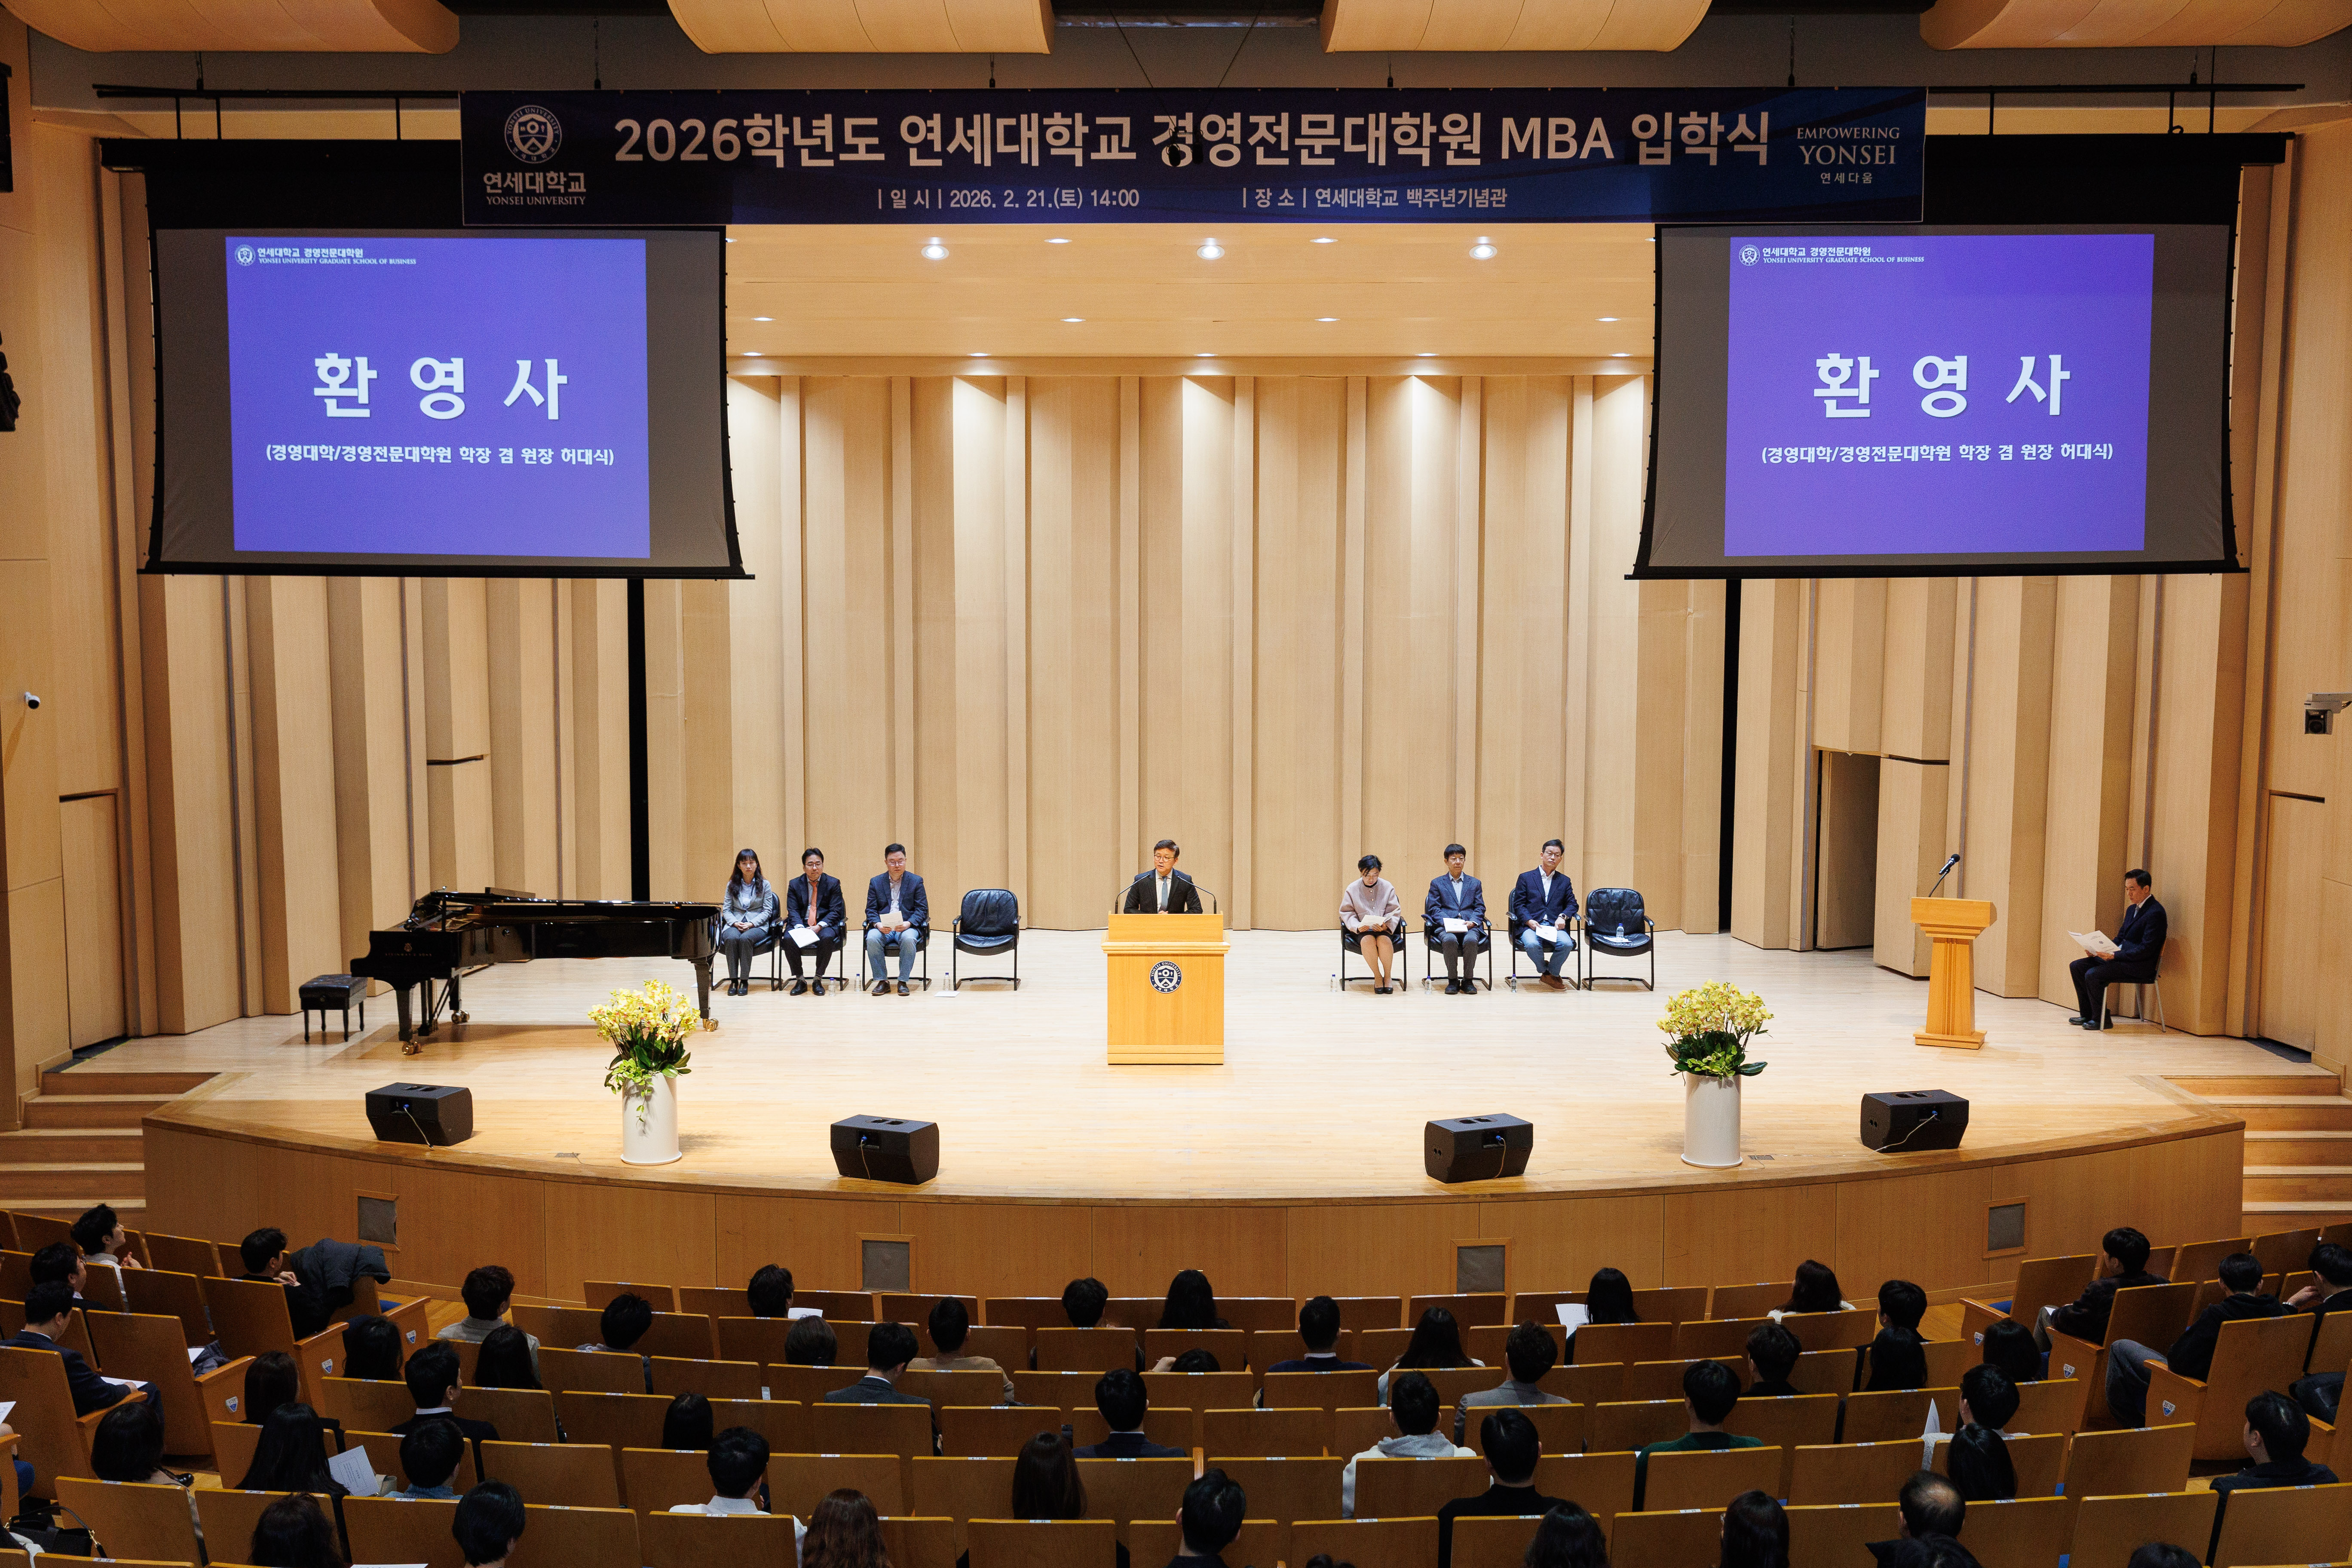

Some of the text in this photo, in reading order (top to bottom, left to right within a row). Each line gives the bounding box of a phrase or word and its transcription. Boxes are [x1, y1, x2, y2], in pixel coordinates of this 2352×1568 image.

[615, 112, 1768, 168] 2026학년도 연세대학교 경영전문대학원 MBA 입학식
[1797, 127, 1899, 139] EMPOWERING
[1800, 145, 1895, 165] YONSEI
[484, 172, 586, 193] 연세대학교
[487, 196, 585, 205] YONSEI UNIVERSITY
[1091, 189, 1139, 206] 14:00
[1316, 188, 1398, 208] 연세대학교
[1407, 188, 1507, 208] 백주년기념관
[257, 248, 363, 257] 연세대학교 경영전문대학원
[1763, 247, 1805, 256] 연세대학교
[1810, 247, 1870, 256] 경영전문대학원
[267, 445, 613, 465] (경영대학/경영전문대학원 학장 겸 원장 허대식)
[1762, 444, 2113, 463] (경영대학/경영전문대학원 학장 겸 원장 허대식)
[1151, 962, 1181, 977] YONSEI UNIVERSITY
